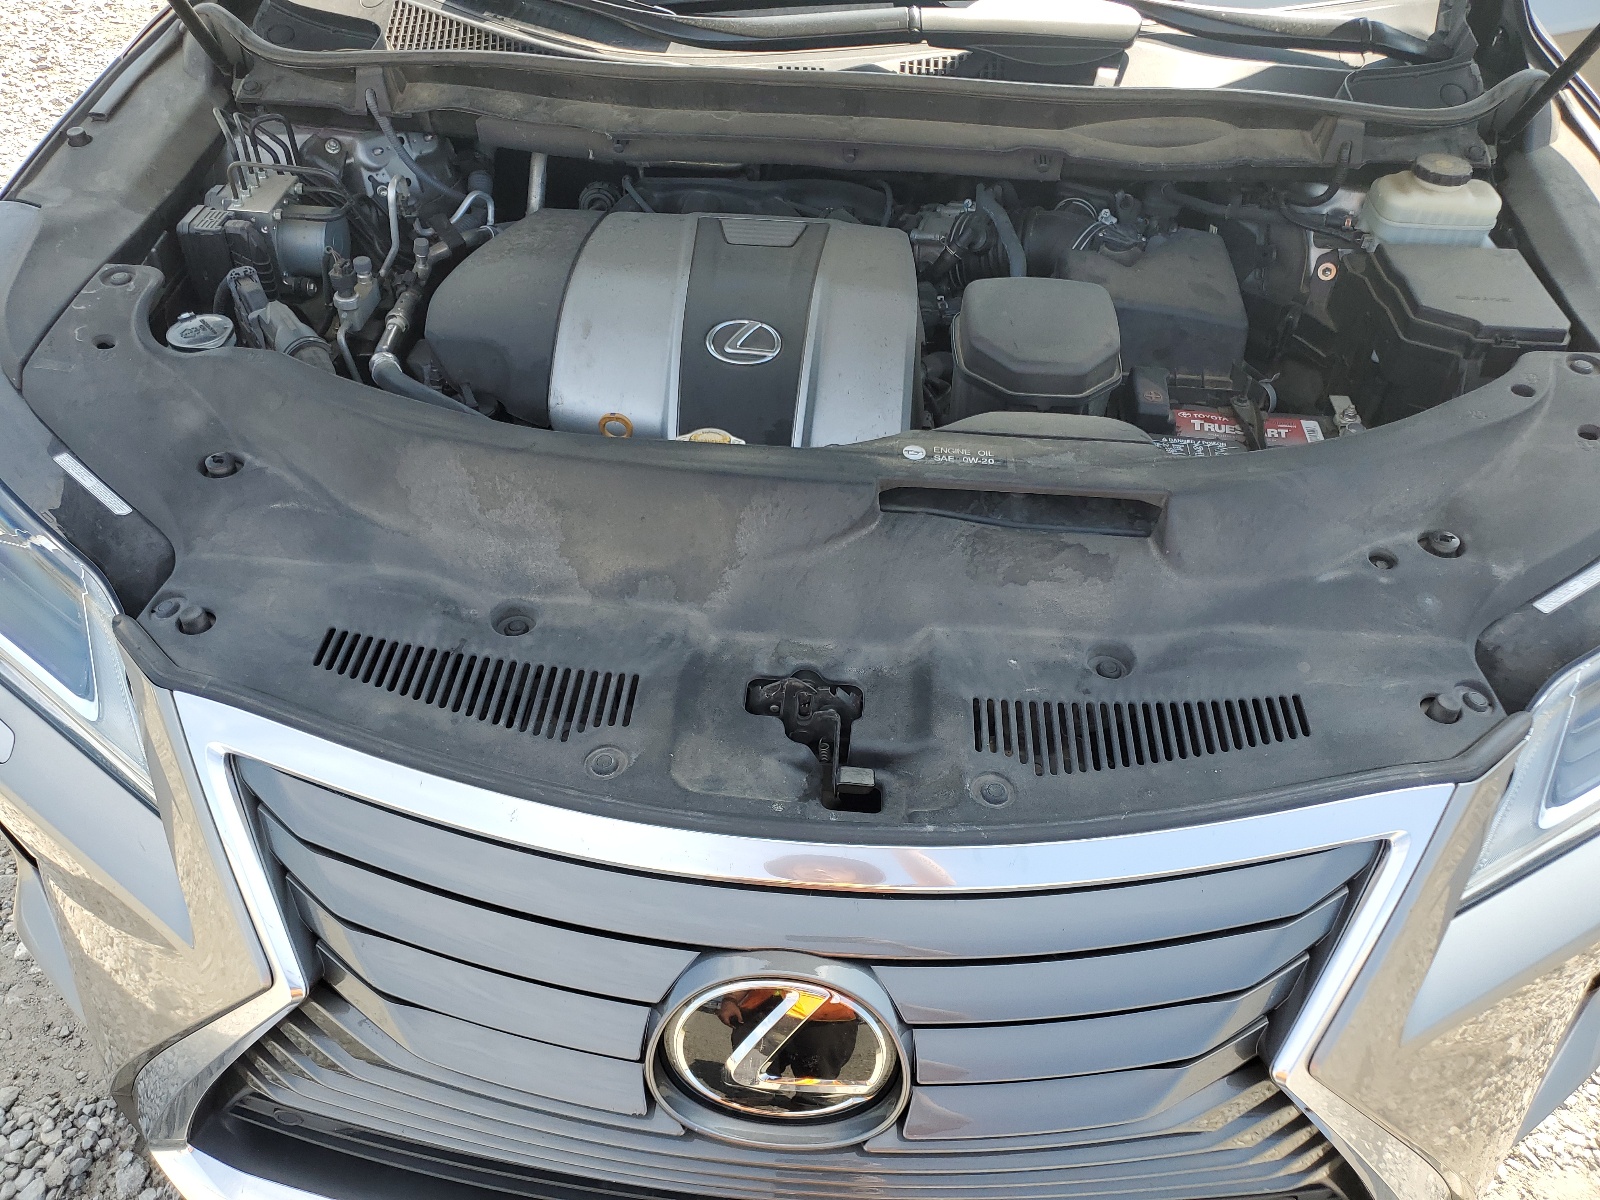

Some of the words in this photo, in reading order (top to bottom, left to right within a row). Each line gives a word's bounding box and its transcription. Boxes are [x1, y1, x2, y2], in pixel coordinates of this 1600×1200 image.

[1193, 412, 1229, 422] TOYOTA
[1191, 419, 1289, 438] TRUESRT
[933, 446, 971, 456] ENGINE
[933, 454, 955, 463] SAE
[962, 456, 995, 465] 0W-20
